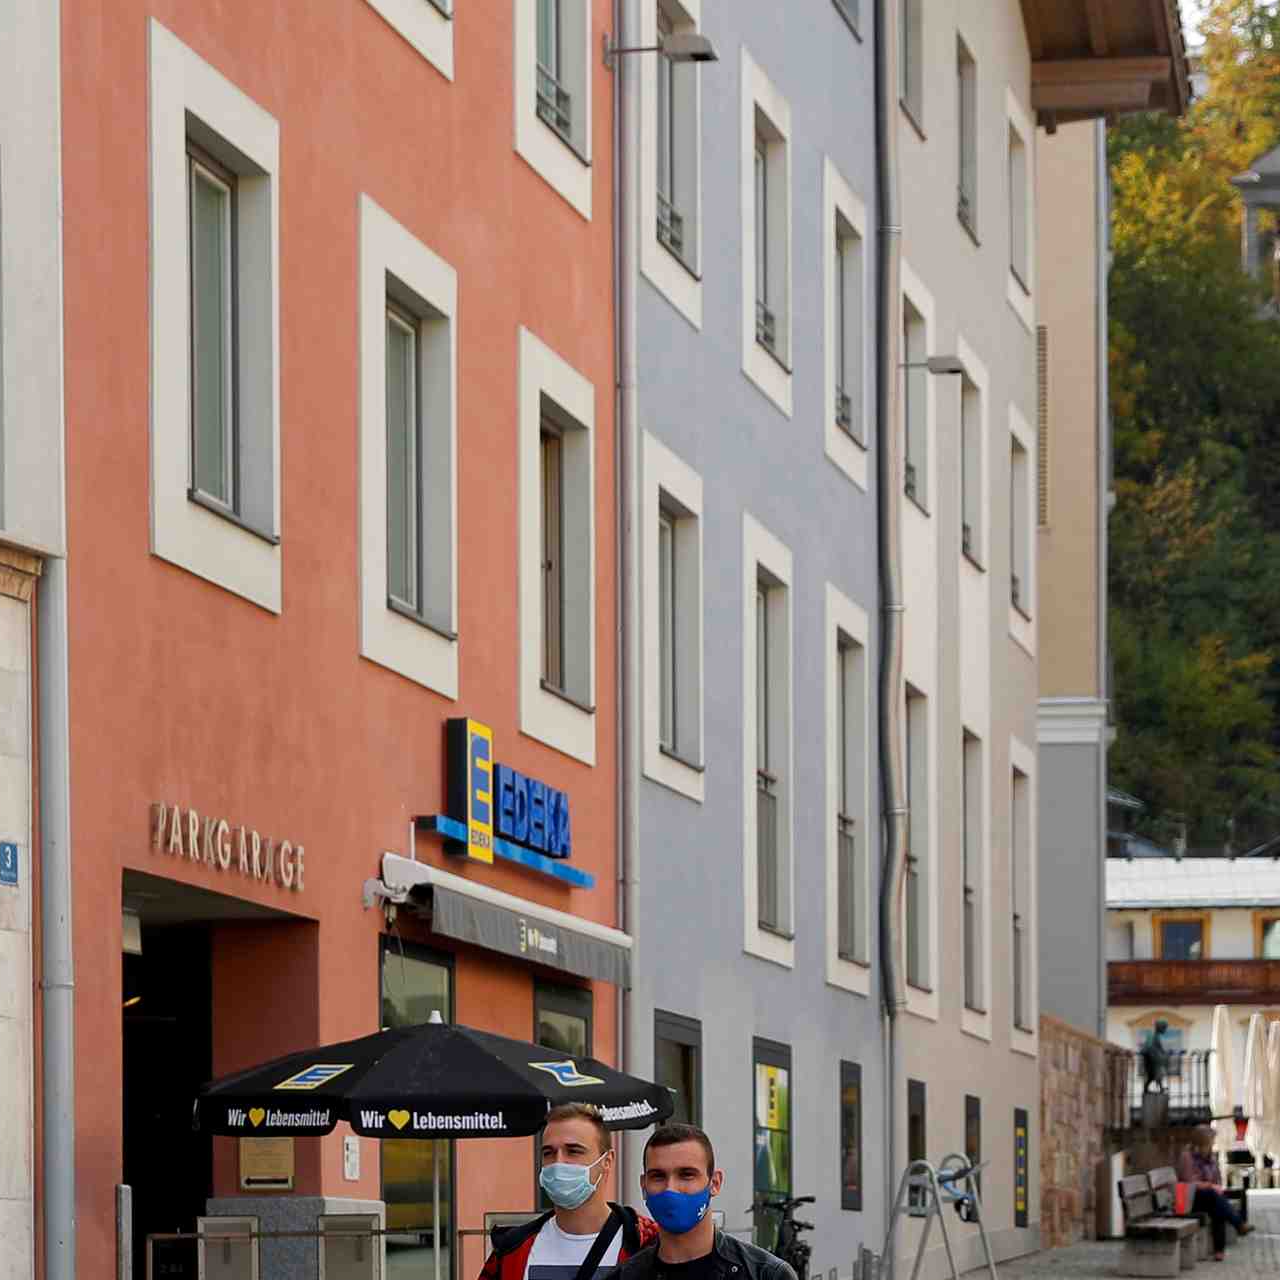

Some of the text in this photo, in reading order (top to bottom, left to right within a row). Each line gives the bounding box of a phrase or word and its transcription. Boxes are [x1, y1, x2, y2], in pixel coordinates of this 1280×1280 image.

[498, 766, 571, 858] EDEKA
[4, 845, 12, 868] 3
[227, 1108, 247, 1126] Wir
[360, 1110, 507, 1130] Wir Lebensmittel.
